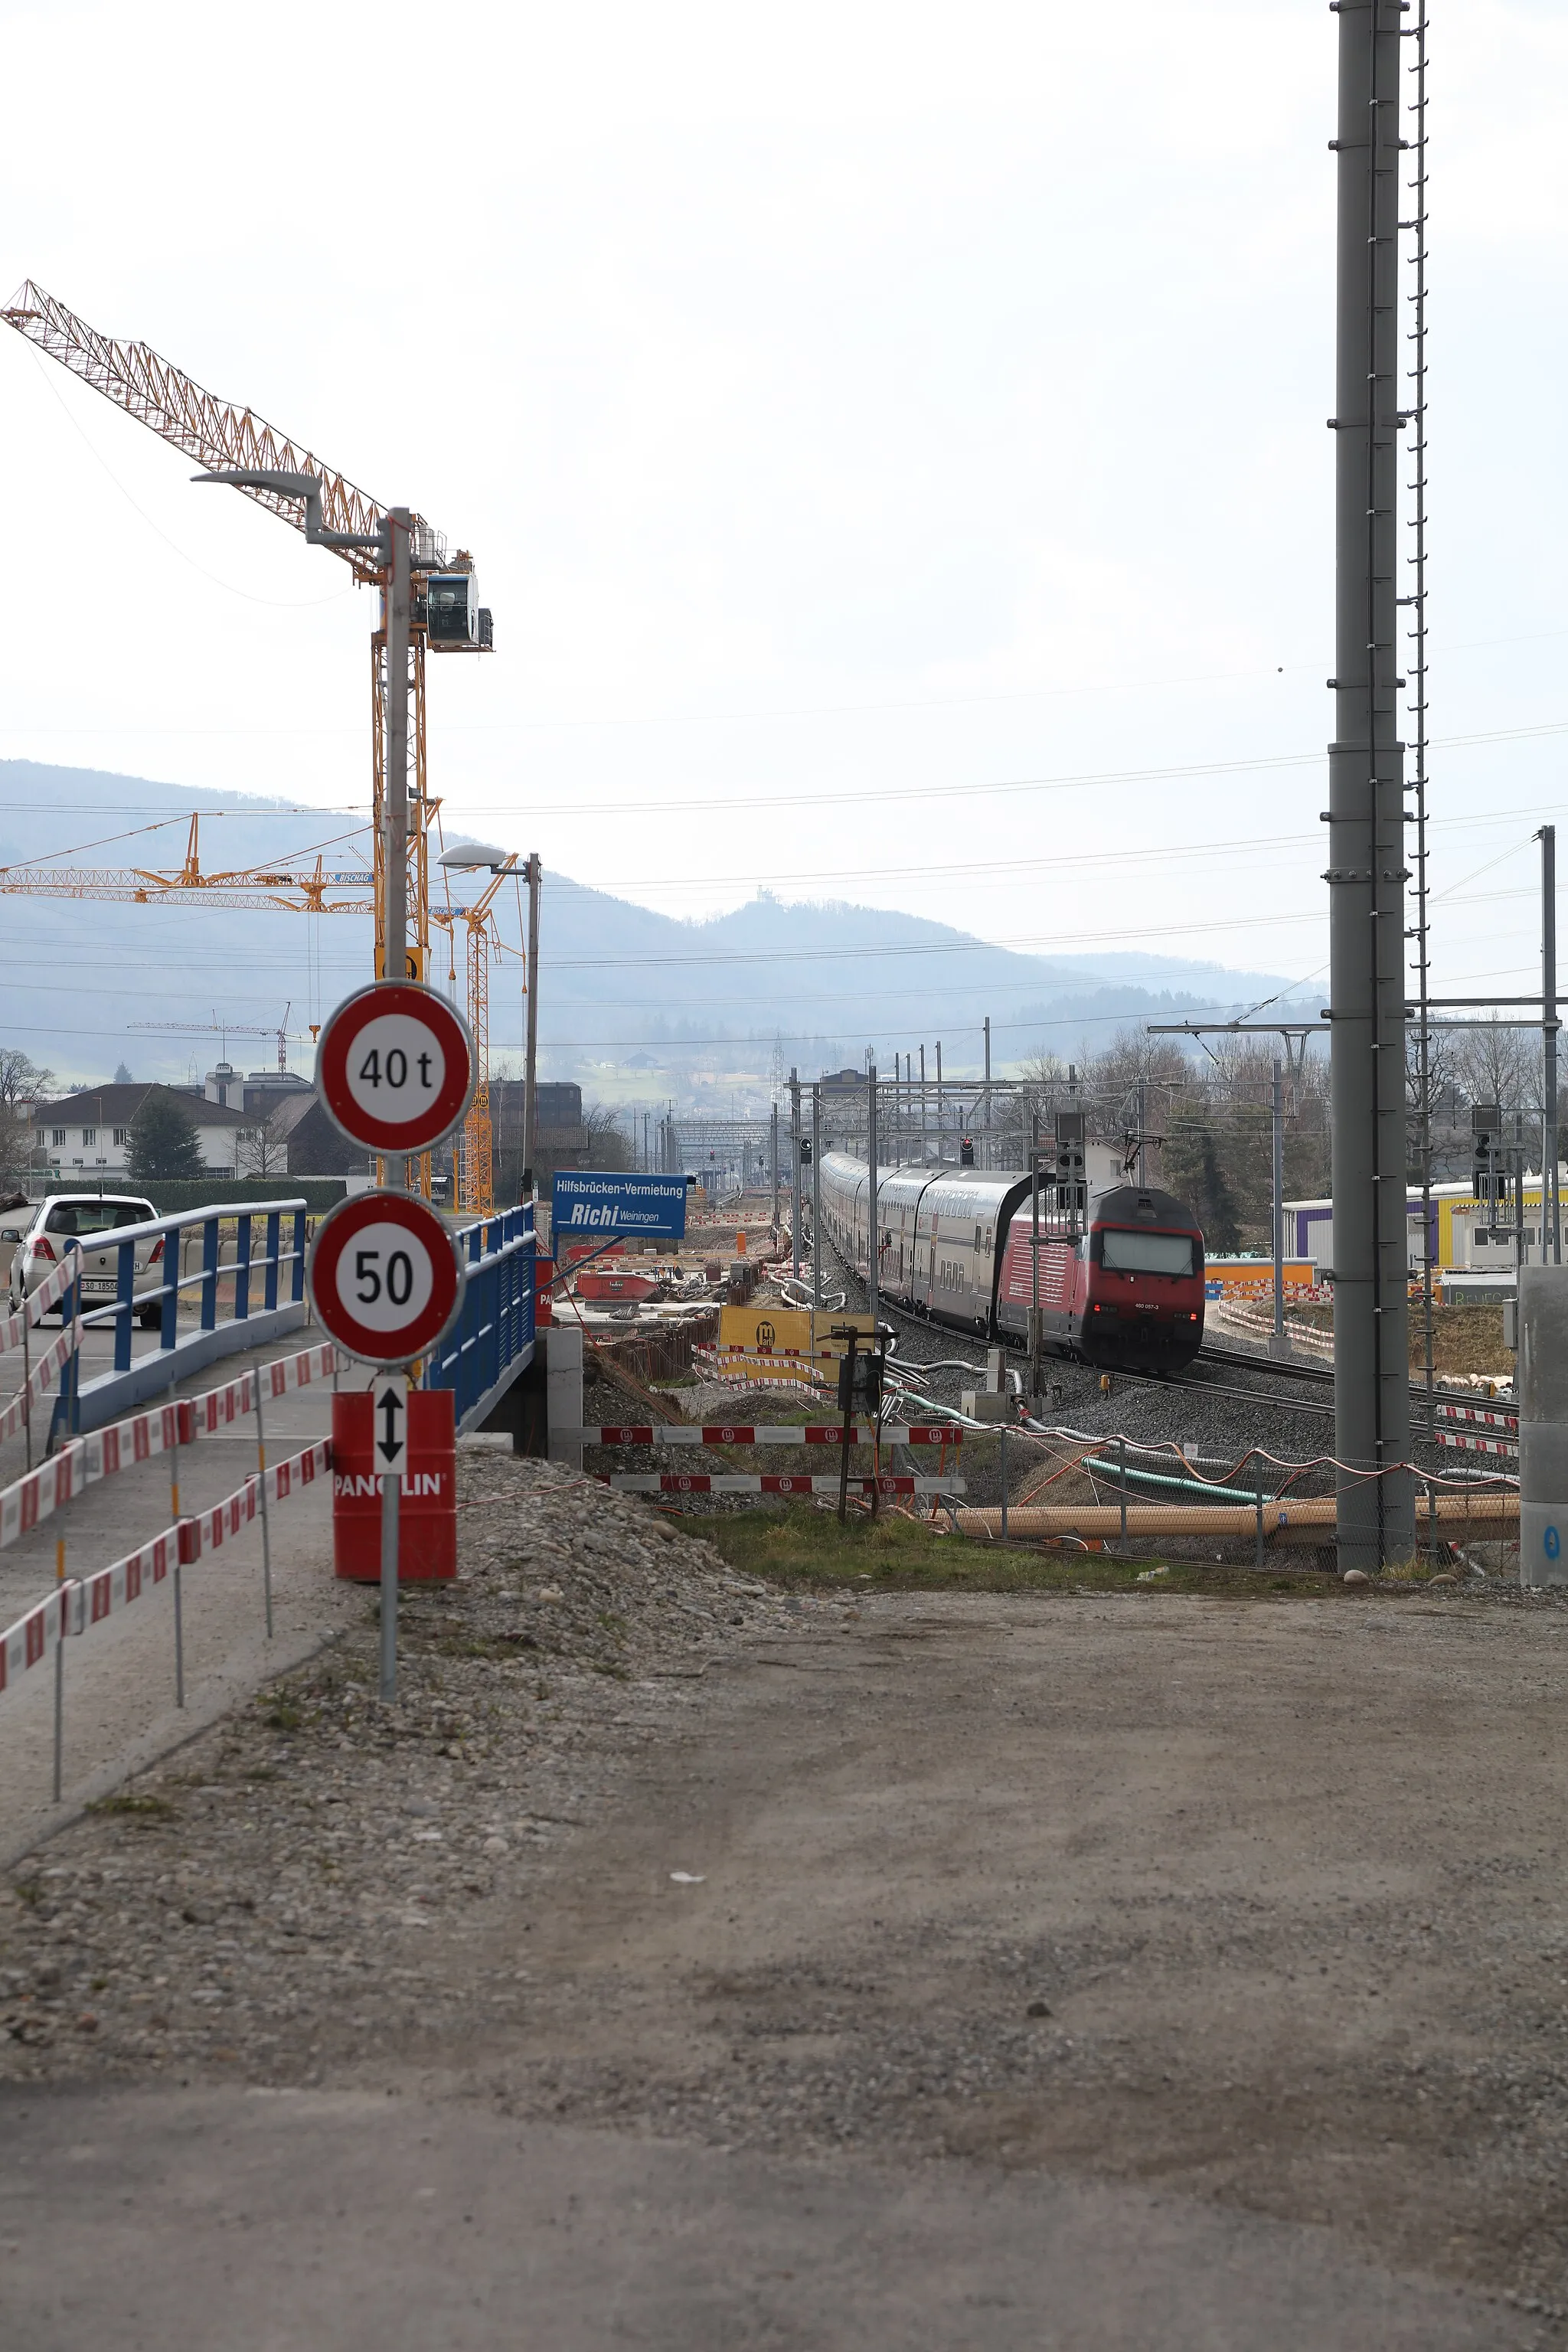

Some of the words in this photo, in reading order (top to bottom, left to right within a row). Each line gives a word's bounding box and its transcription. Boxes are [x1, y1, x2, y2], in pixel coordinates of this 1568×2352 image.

[338, 874, 370, 882] BISCHAG
[359, 1049, 407, 1088] 40
[416, 1052, 433, 1088] t
[557, 1180, 683, 1199] Hilfsbrücken-Vermietung
[569, 1203, 619, 1226] Richi
[620, 1210, 659, 1223] Weiningen
[355, 1250, 413, 1305] 50
